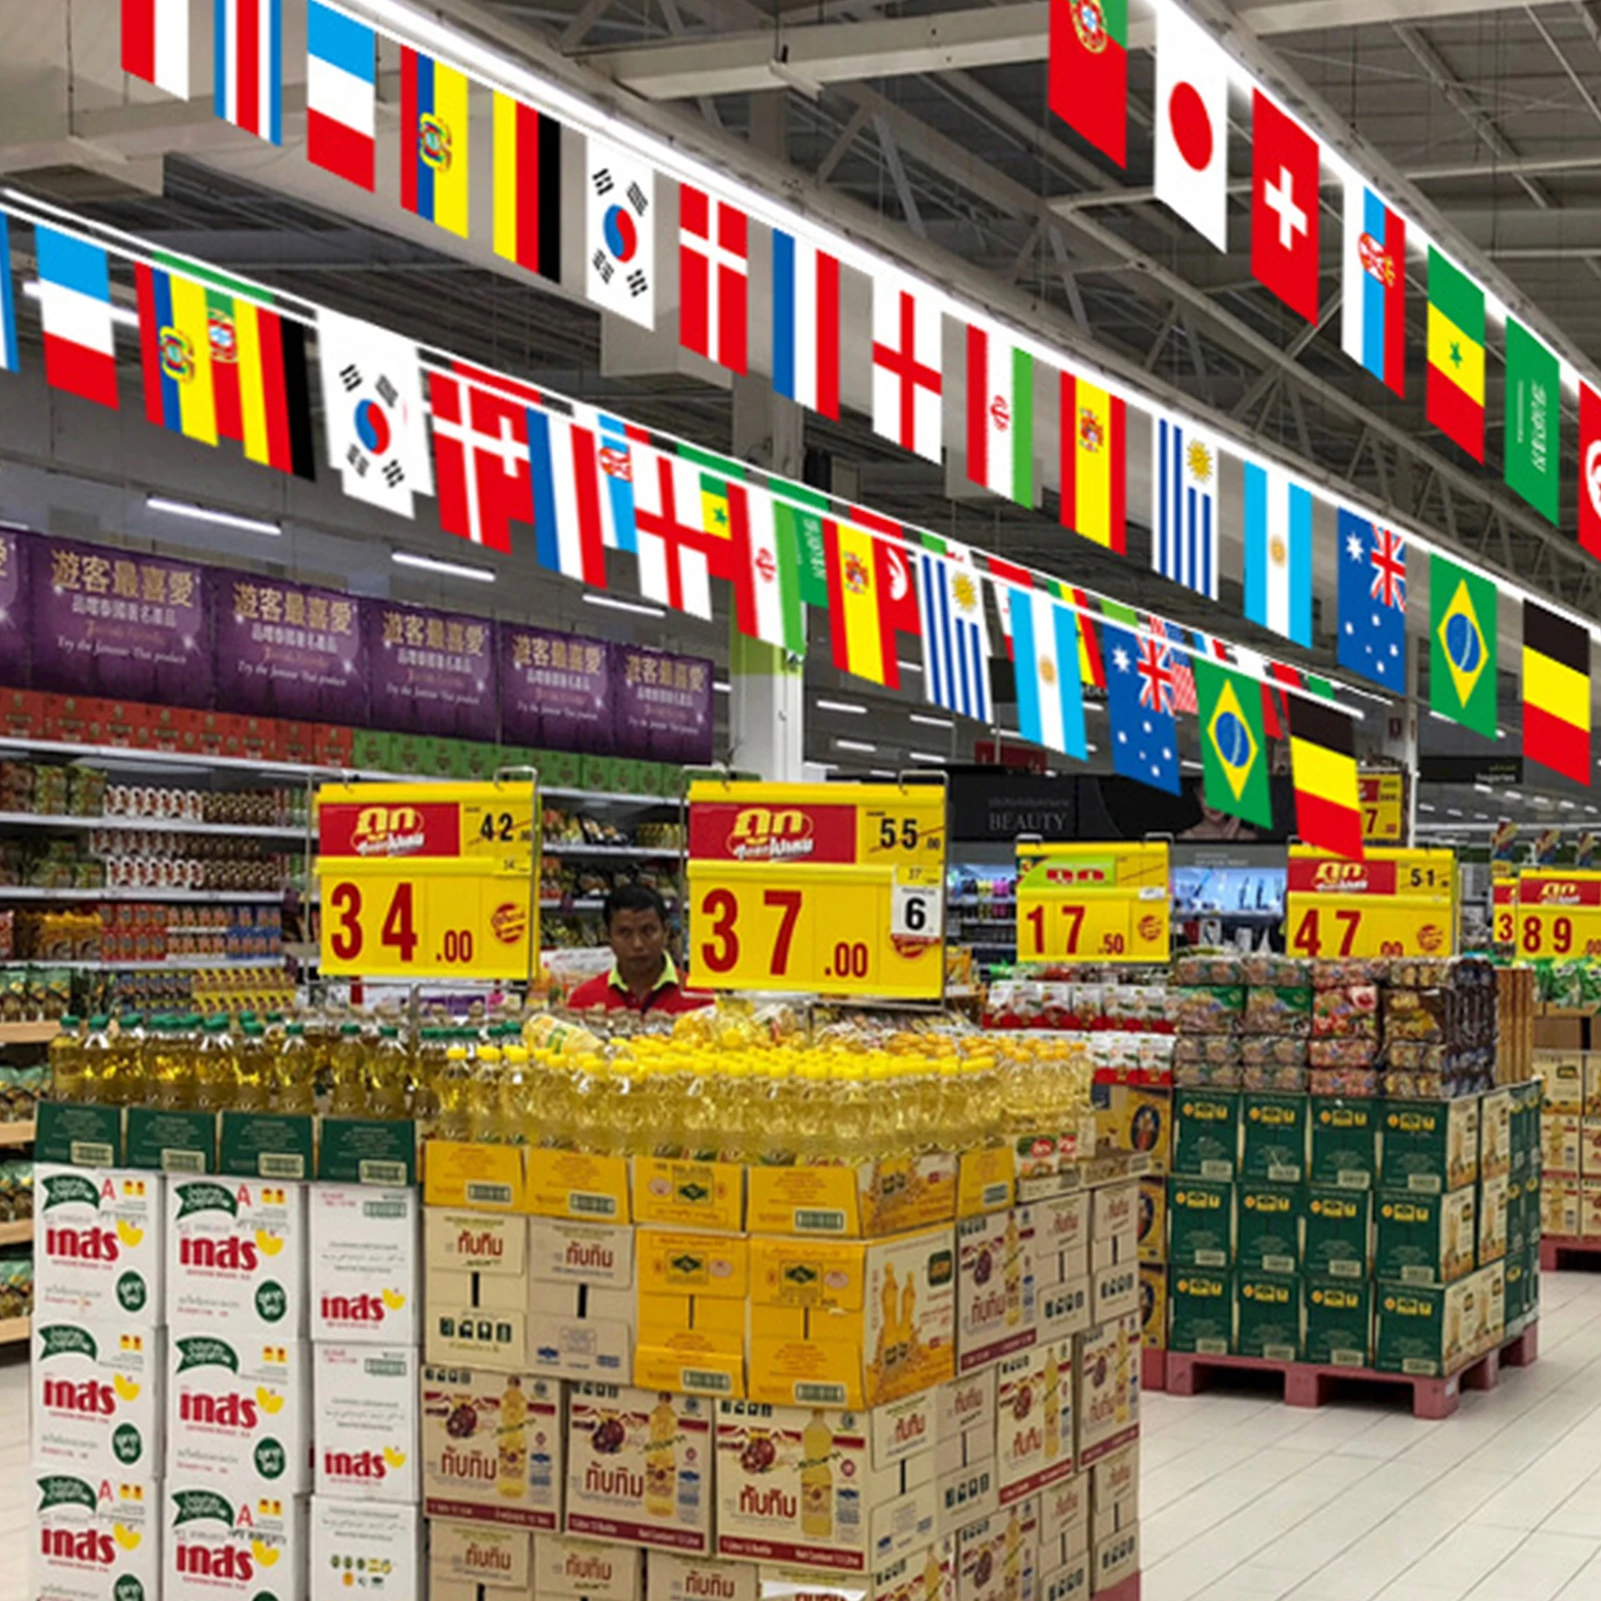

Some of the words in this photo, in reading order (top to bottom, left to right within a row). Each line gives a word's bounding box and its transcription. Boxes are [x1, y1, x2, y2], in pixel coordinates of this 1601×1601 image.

[480, 812, 513, 842] 42
[880, 818, 918, 849] 55
[989, 813, 1066, 831] BEAUTY
[1411, 868, 1434, 887] 51
[330, 881, 418, 962] 34
[905, 897, 926, 930] 6
[1027, 904, 1086, 955] 17
[701, 888, 802, 976] 37
[1294, 908, 1362, 957] 47
[1523, 916, 1572, 954] 89
[458, 1229, 503, 1256] ทับทิม
[566, 1240, 613, 1268] ทับทิม
[441, 1445, 497, 1480] ทับทิม
[586, 1461, 644, 1498] ทับทิม
[739, 1484, 797, 1518] ทับทิม
[466, 1543, 511, 1570] ทับทิม
[566, 1554, 612, 1581] ทับทิม
[685, 1571, 735, 1599] ทับทิม
